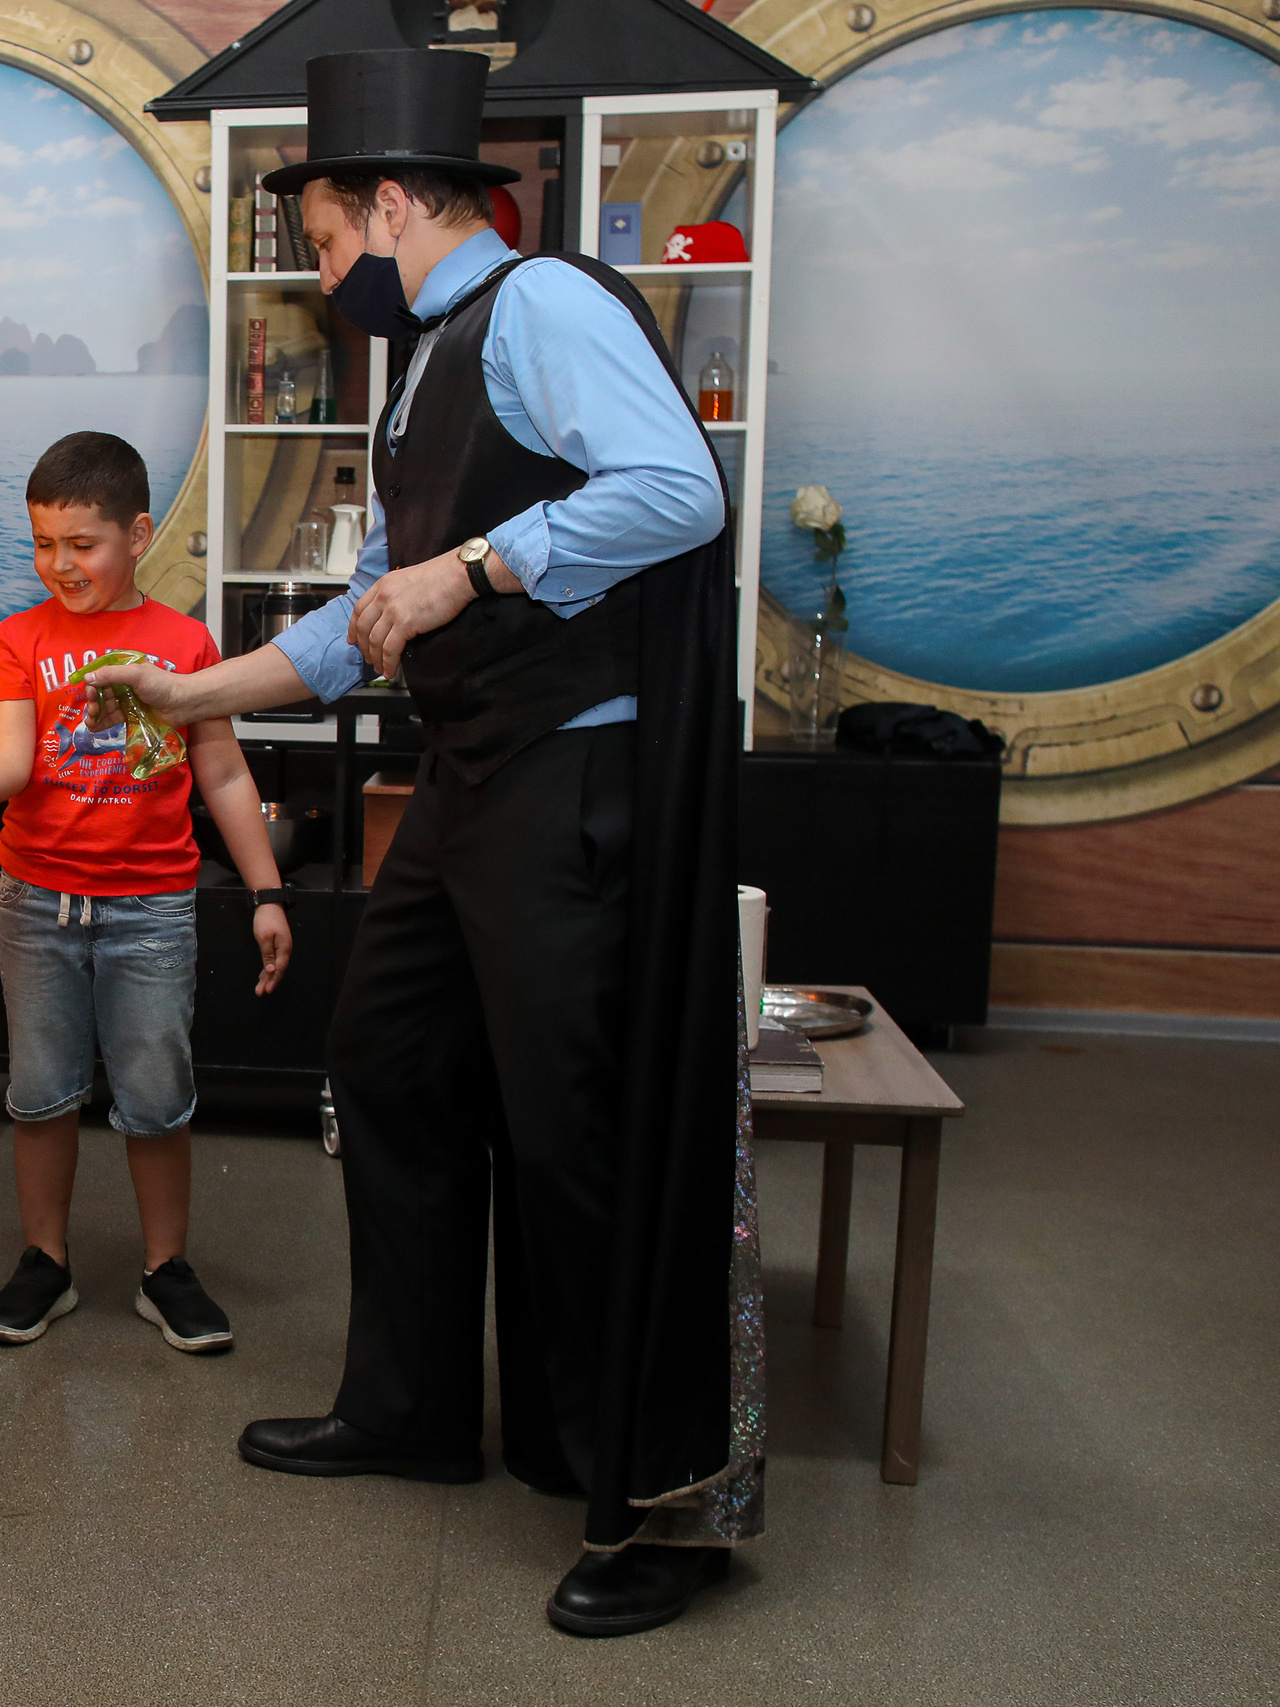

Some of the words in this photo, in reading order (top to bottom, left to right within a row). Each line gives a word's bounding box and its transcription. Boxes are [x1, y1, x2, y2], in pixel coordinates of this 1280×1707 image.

[79, 758, 93, 770] THE
[96, 757, 126, 768] COOLES
[44, 776, 87, 793] SUSSEX
[93, 785, 108, 795] TO
[113, 780, 160, 795] DORSET
[70, 793, 95, 804] DAWN
[97, 797, 133, 805] PATROL
